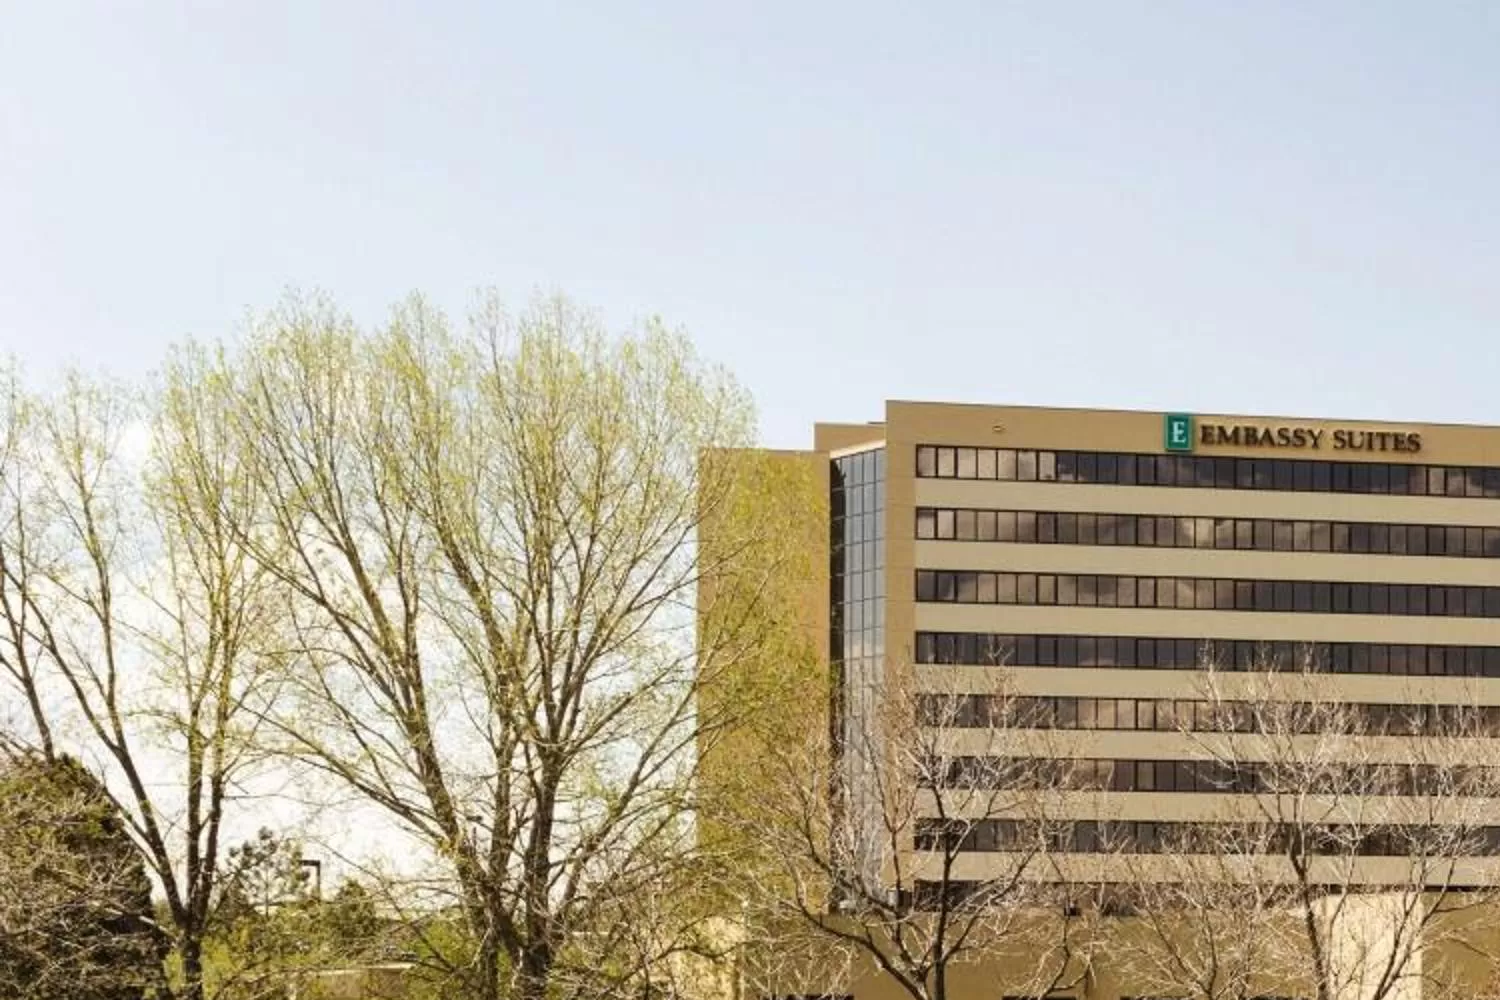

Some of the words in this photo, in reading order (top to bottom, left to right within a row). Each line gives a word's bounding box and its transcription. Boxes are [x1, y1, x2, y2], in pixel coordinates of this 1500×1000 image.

[1172, 421, 1186, 444] E
[1200, 425, 1323, 449] EMBASSY
[1333, 429, 1421, 453] SUITES
